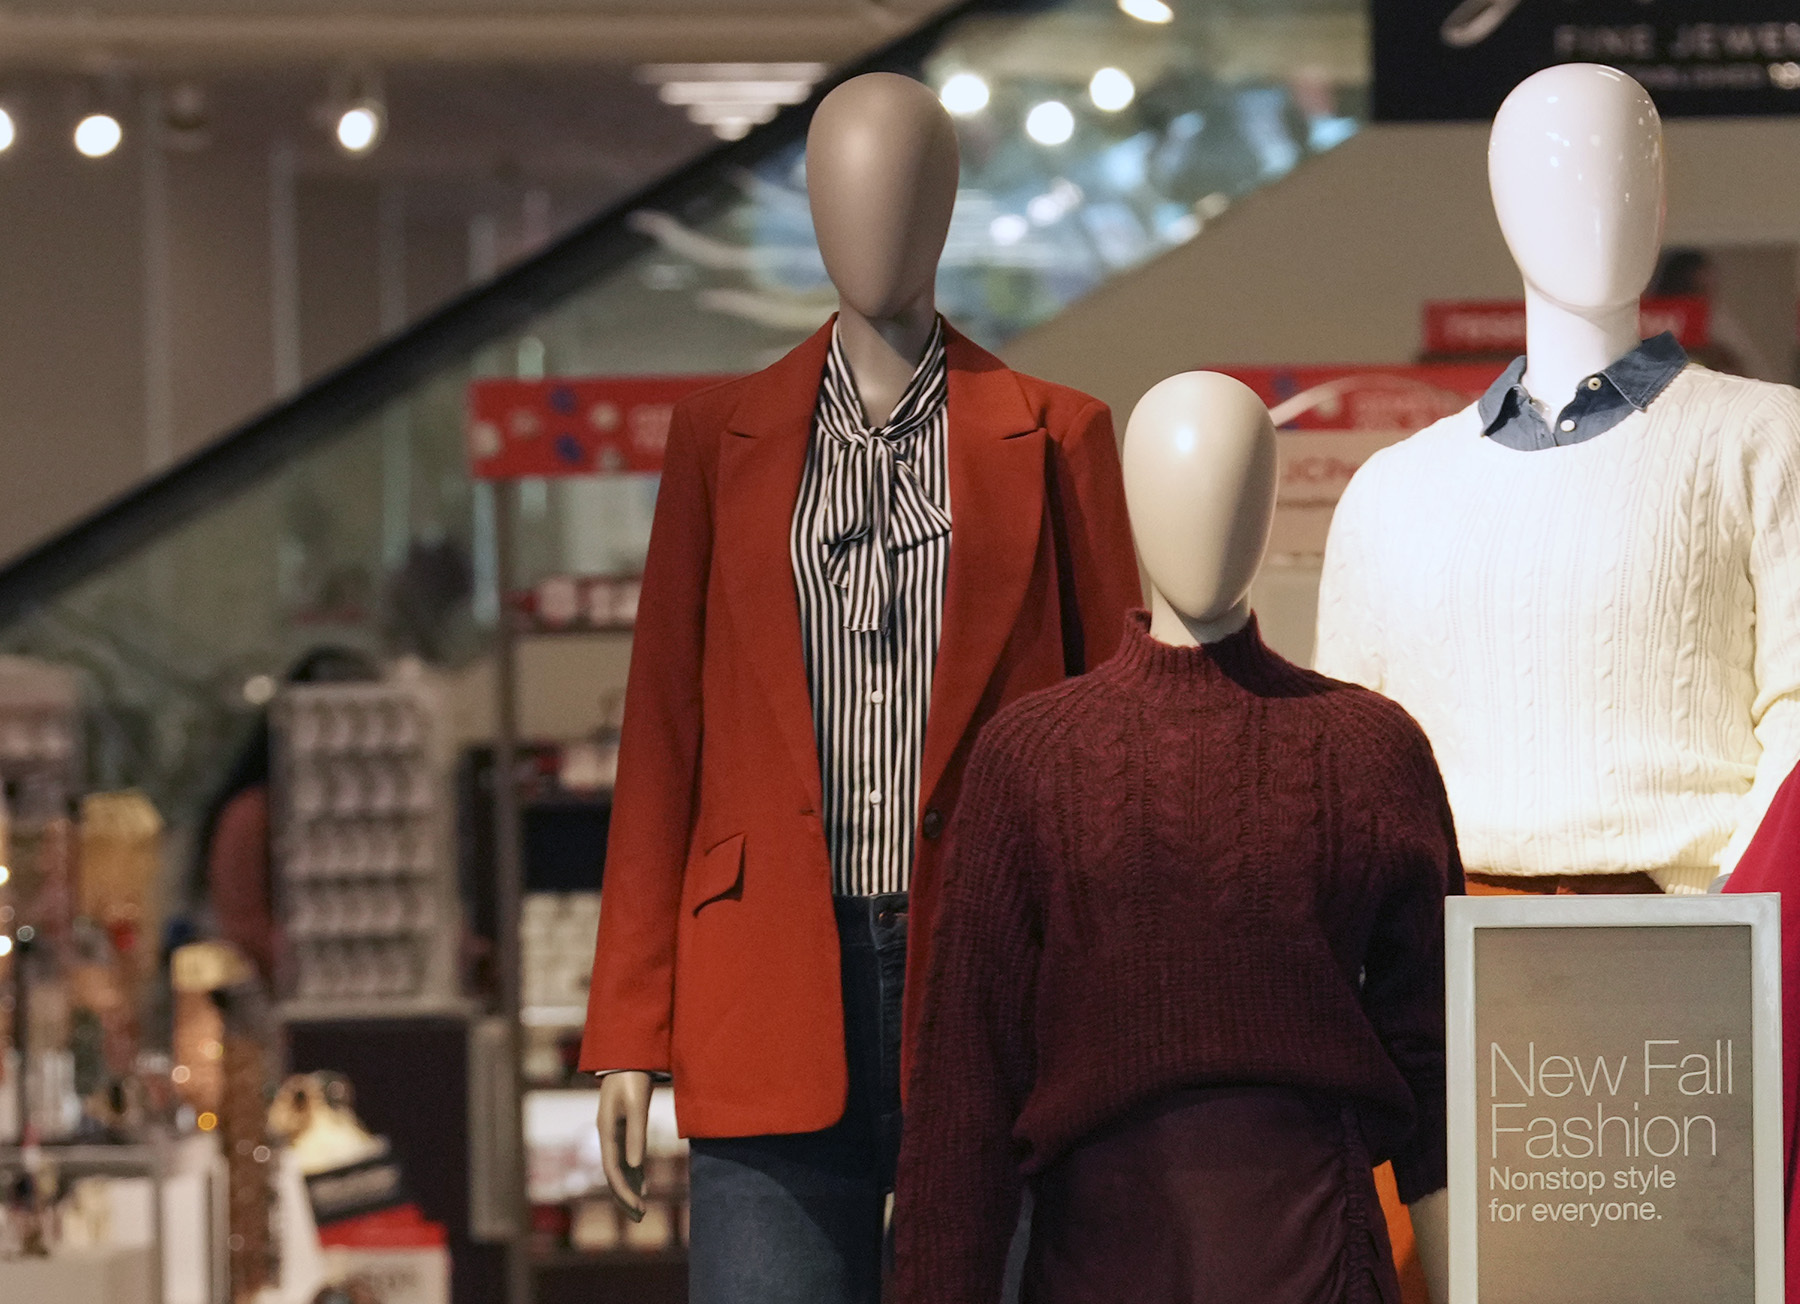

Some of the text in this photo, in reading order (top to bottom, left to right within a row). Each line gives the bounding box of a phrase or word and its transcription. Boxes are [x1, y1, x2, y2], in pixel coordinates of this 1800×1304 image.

[1554, 23, 1655, 56] FINE
[1490, 1039, 1733, 1097] New Fall
[1491, 1102, 1717, 1159] Fashion
[1489, 1164, 1677, 1195] Nonstop style
[1488, 1198, 1663, 1227] for everyone.
